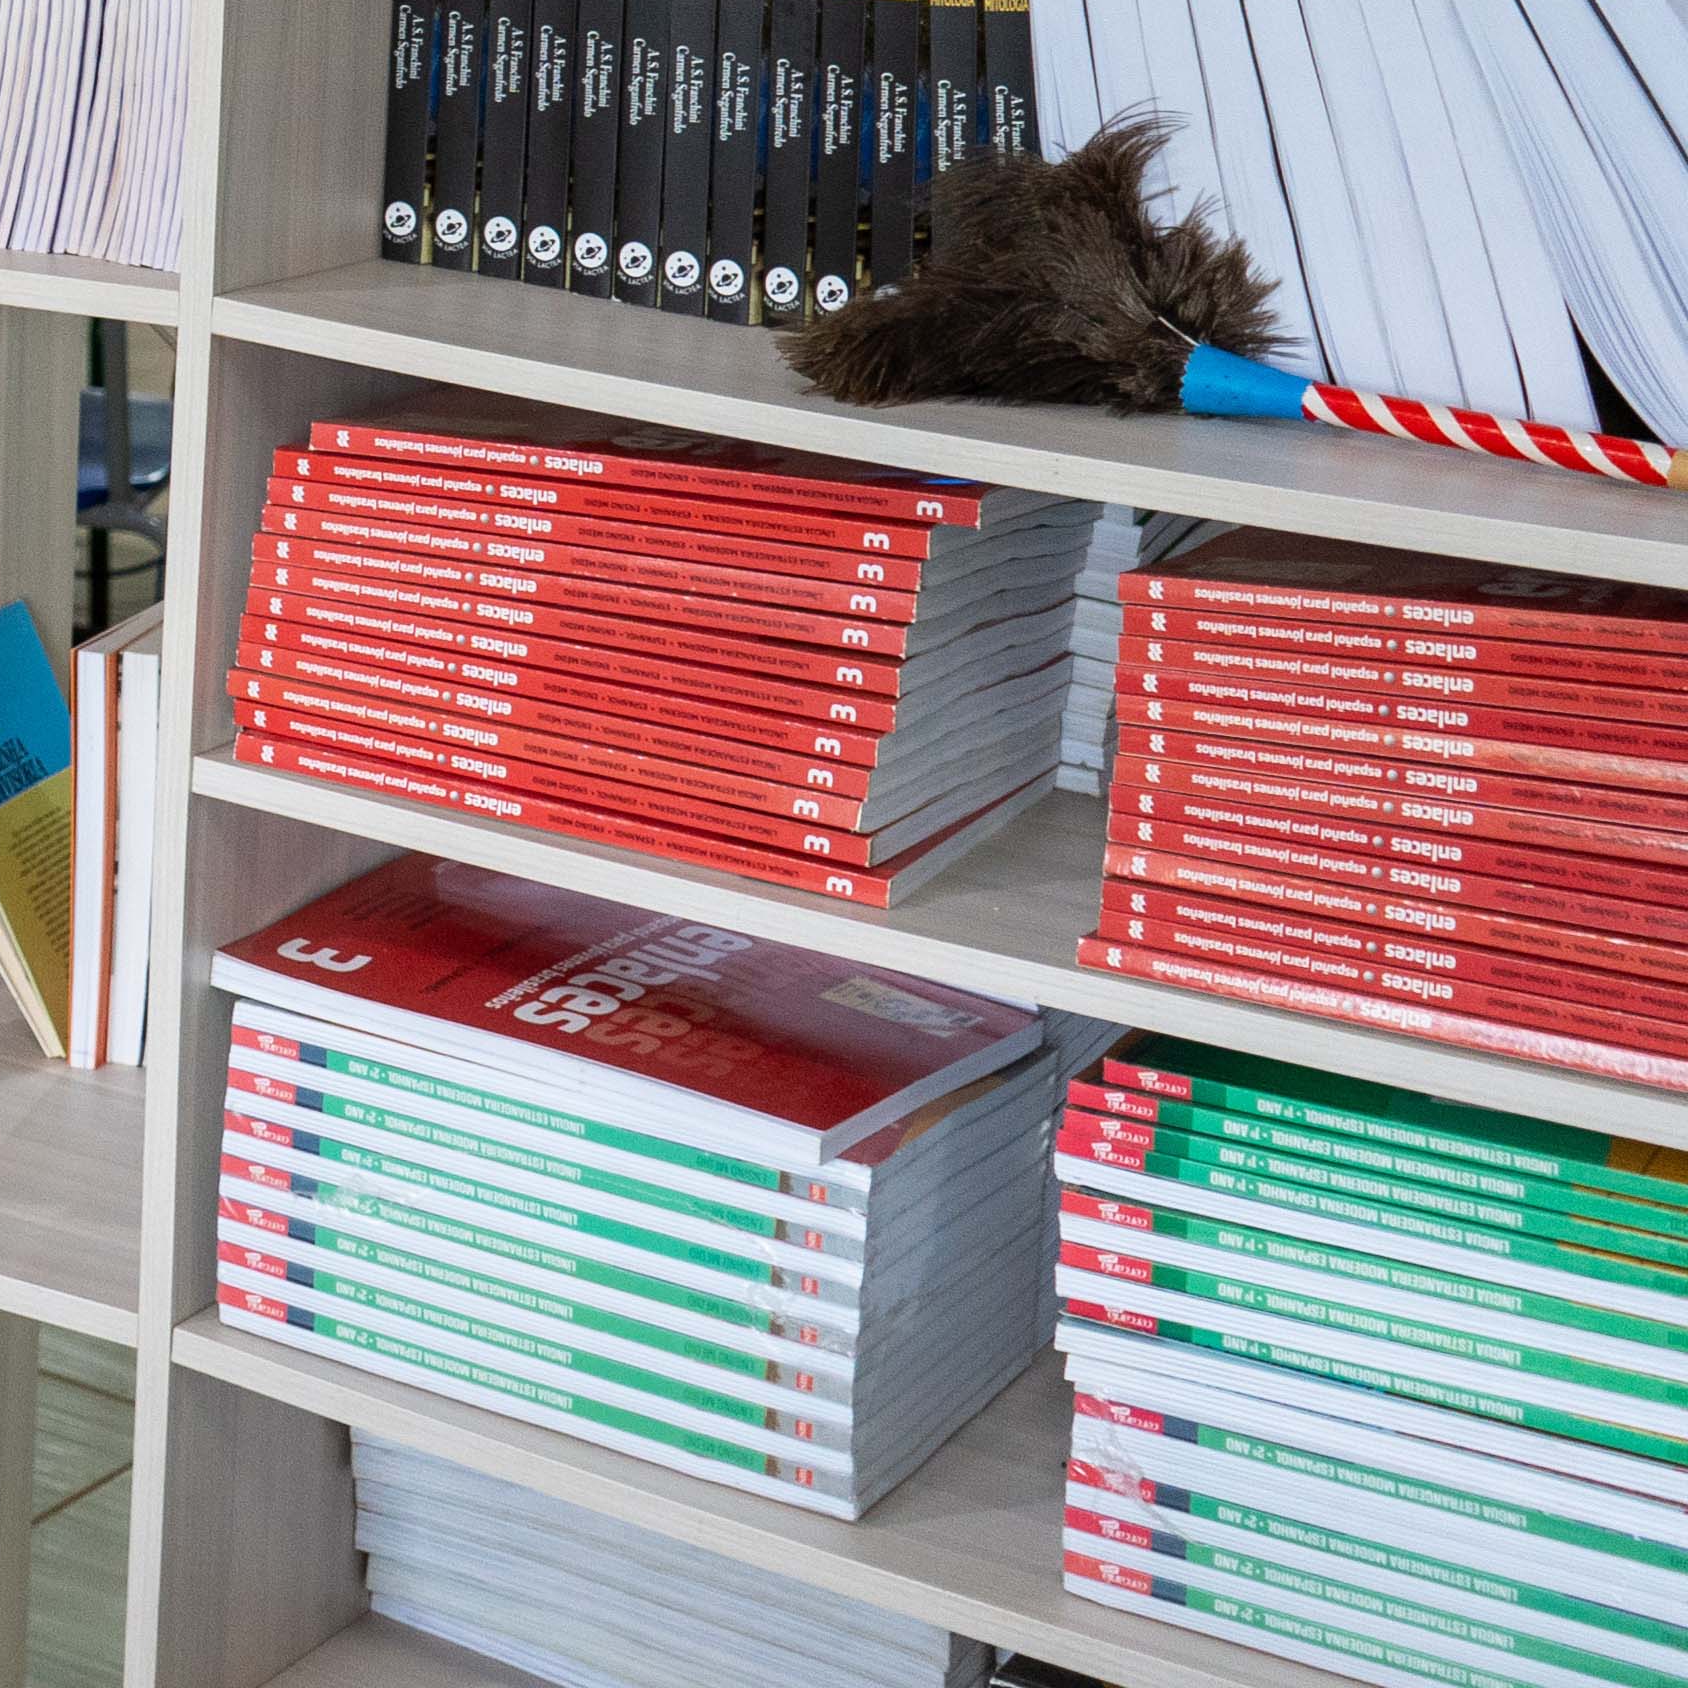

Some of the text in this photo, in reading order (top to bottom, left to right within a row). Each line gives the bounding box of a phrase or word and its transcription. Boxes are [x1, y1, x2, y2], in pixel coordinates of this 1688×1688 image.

[444, 11, 461, 96] Carmen Seganfredo
[460, 43, 474, 86] Franchini
[493, 16, 510, 102] Carmen Seganfredo
[509, 50, 523, 93] Franchini
[772, 59, 790, 148] Carmen Seganfredo
[789, 93, 803, 138] Franchini
[876, 72, 894, 164] Carmen Seganfredo
[894, 107, 907, 153] Franchini
[446, 240, 469, 254] LACTEA
[494, 247, 519, 261] LACTEA
[775, 299, 801, 312] LACTEA
[375, 438, 603, 475] enlaces español para jóvenes brasileños
[329, 494, 551, 534] enlaces español para jóvenes brasileños
[917, 501, 943, 518] 3
[858, 564, 883, 581] 3
[1195, 589, 1474, 626] enlaces español para jóvenes brasileños
[301, 634, 517, 686] enlaces español para jóvenes brasileños
[1189, 683, 1468, 728] enlaces español para jóvenes brasileños
[815, 737, 840, 755] 3
[299, 757, 521, 816] enlaces español para jóvenes brasileños
[1184, 806, 1462, 861] enlaces español para jóvenes brasileños
[826, 877, 852, 896] 3
[1177, 906, 1456, 968] enlaces español para jóvenes brasileños
[277, 937, 372, 973] 3
[485, 968, 564, 1009] brasileños
[514, 925, 752, 1034] enlaces
[349, 1061, 368, 1075] ANO
[389, 1072, 434, 1093] ESPANHOL
[433, 1085, 485, 1106] MODERNA
[1258, 1100, 1281, 1114] ANO
[482, 1098, 551, 1124] ESTRANGEIRA
[1305, 1109, 1364, 1133] ESPANHOL
[1366, 1123, 1426, 1146] MODERNA
[1428, 1137, 1512, 1165] ESTRANGEIRA
[1211, 1172, 1233, 1188] ANO
[1258, 1183, 1316, 1207] ESPANHOL
[1319, 1198, 1377, 1222] MODERNA
[1380, 1210, 1463, 1242] ESTRANGEIRA
[336, 1282, 355, 1296] ANO
[373, 1294, 421, 1317] ESPANHOL
[420, 1308, 472, 1331] MODERNA
[469, 1315, 538, 1356] ESTRANGEIRA
